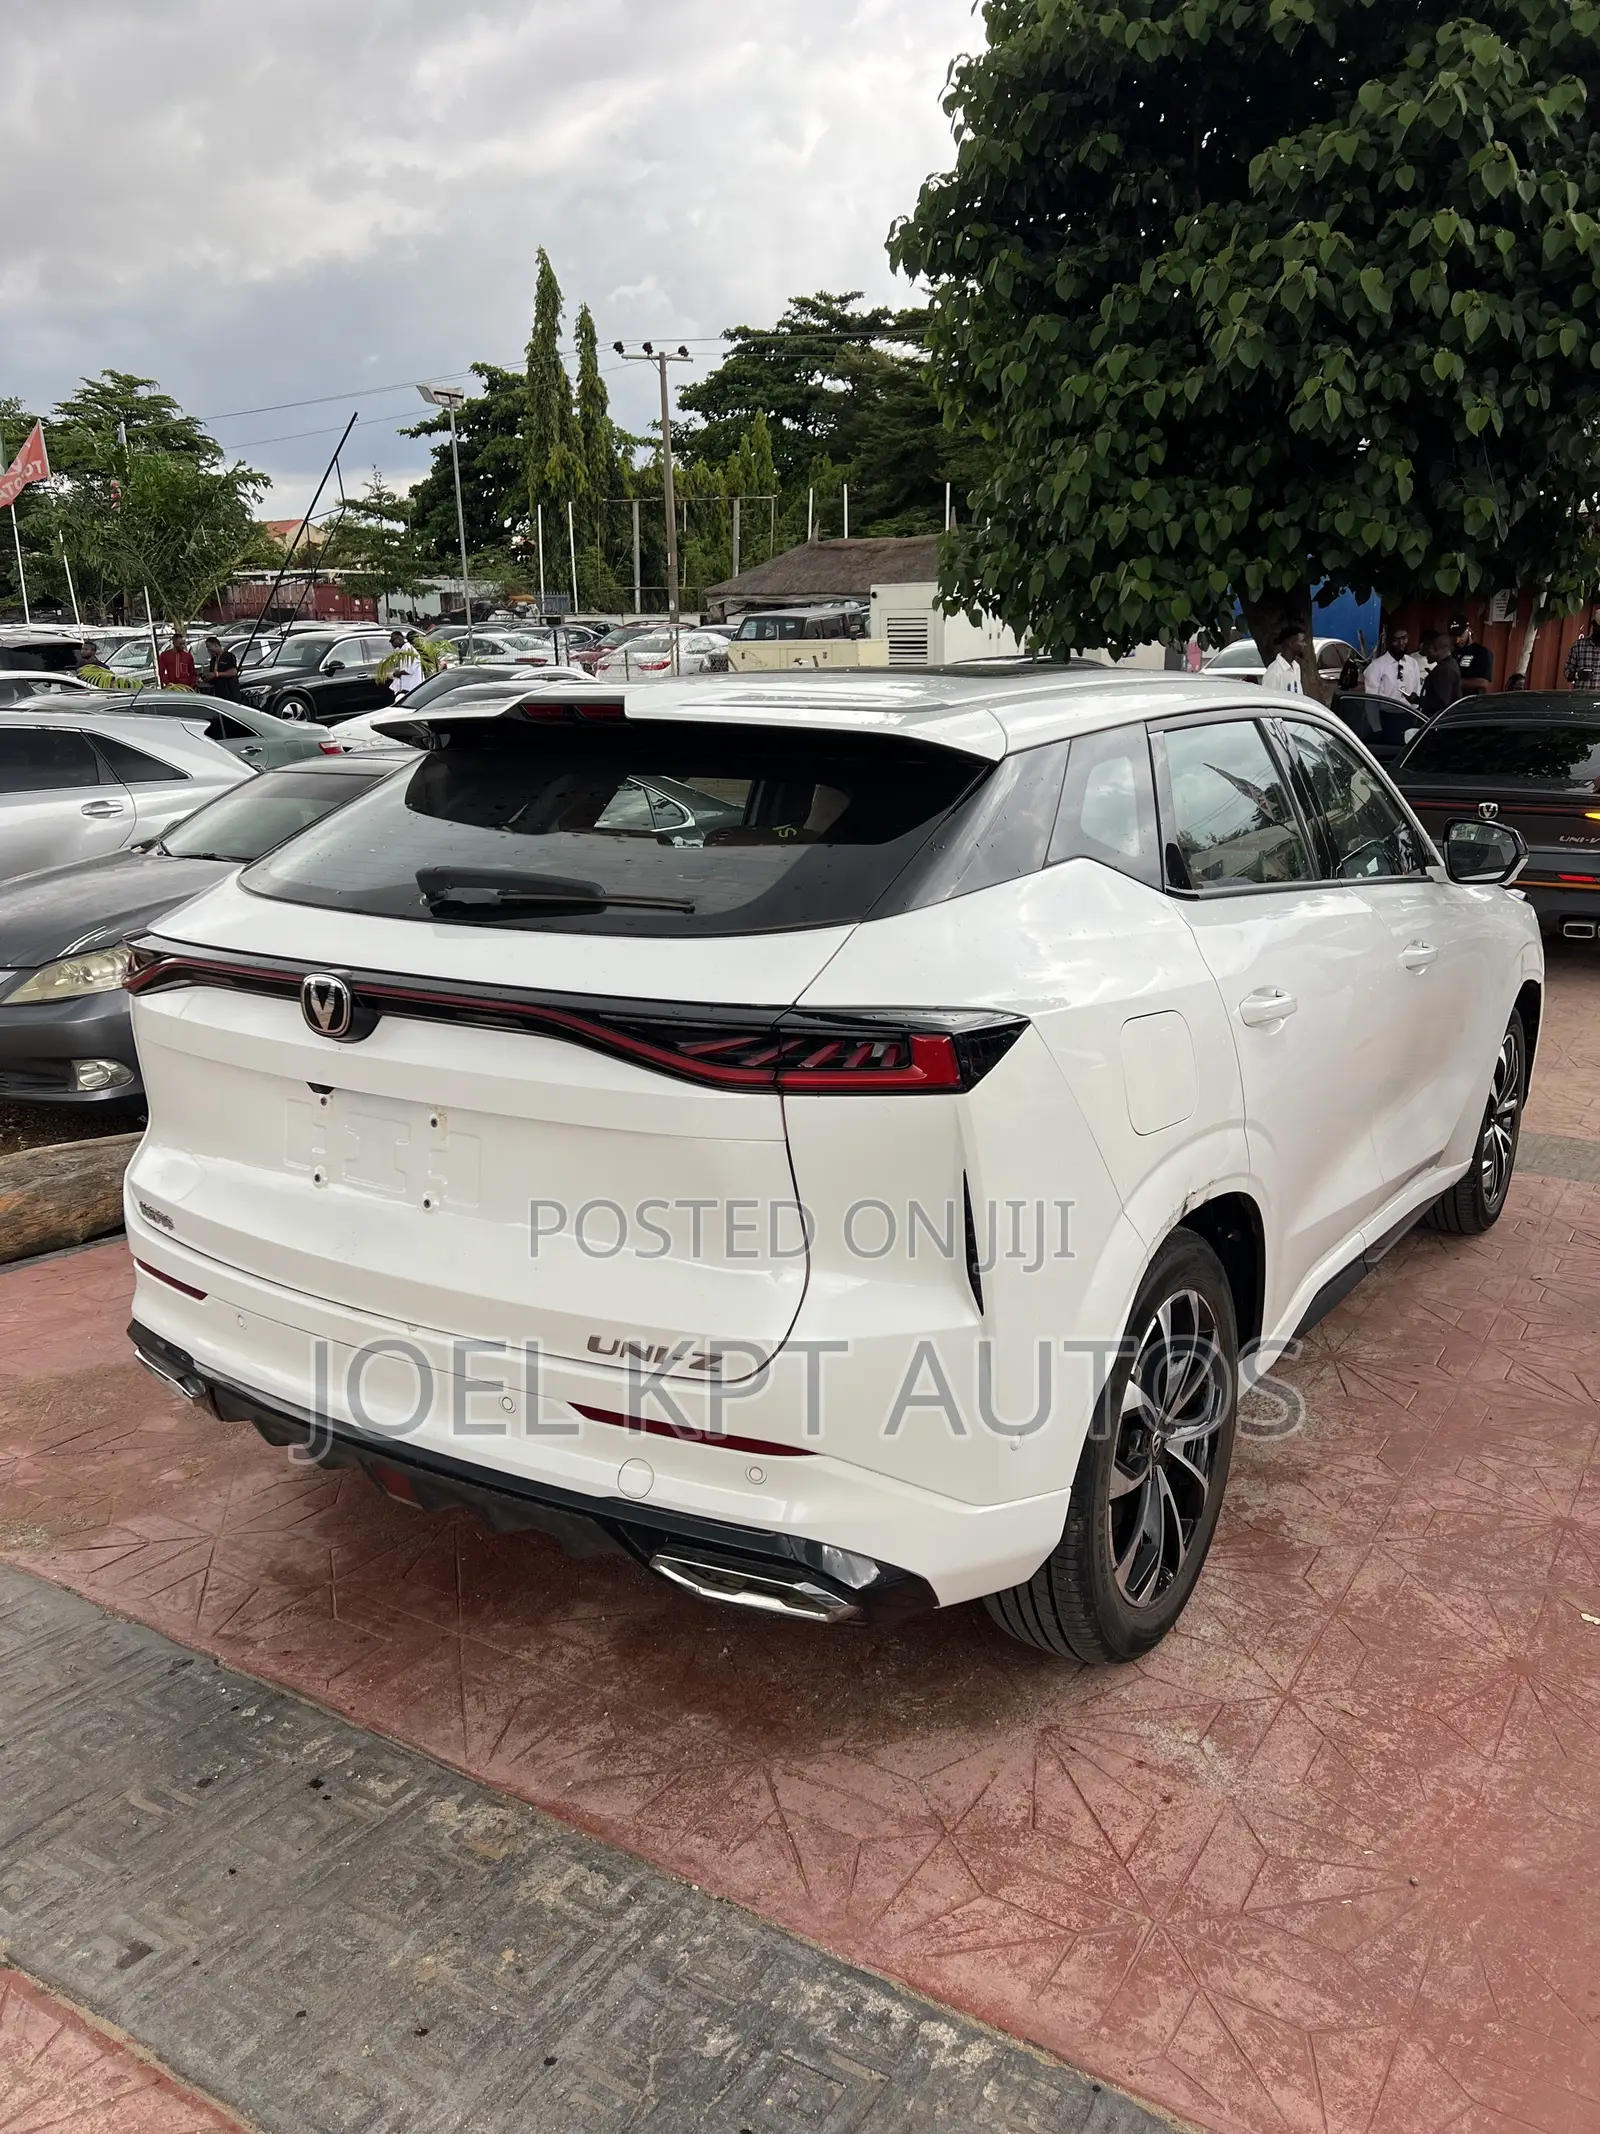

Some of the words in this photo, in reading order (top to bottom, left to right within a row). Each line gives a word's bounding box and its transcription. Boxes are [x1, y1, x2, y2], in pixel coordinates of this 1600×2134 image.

[1559, 835, 1600, 844] UNI-V
[587, 1334, 724, 1372] UNI-Z
[1098, 1496, 1109, 1593] RADIAL
